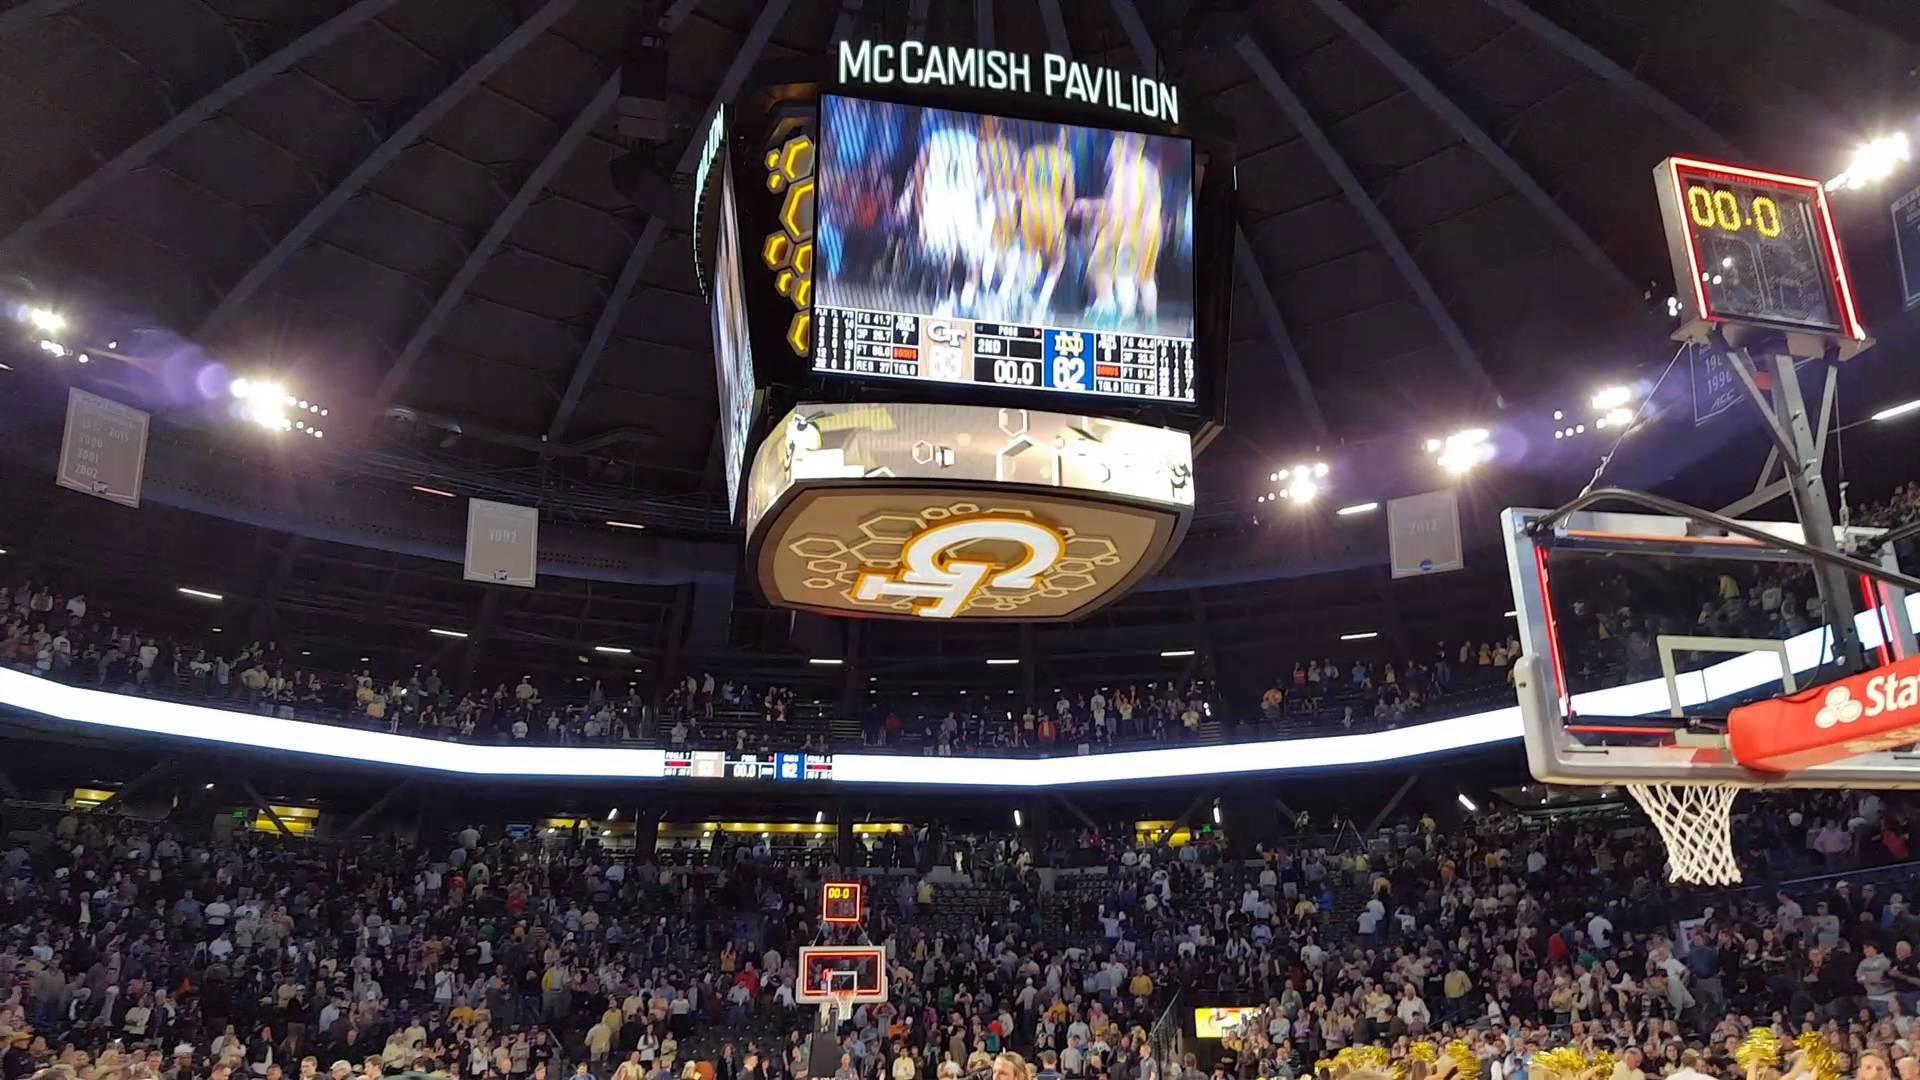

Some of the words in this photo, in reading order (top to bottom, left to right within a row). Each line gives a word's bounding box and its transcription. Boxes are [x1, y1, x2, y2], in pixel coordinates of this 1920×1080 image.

[1043, 52, 1179, 124] PAVILION
[1688, 186, 1781, 238] 00.0
[873, 314, 891, 326] 41.7
[901, 331, 909, 344] 7
[927, 320, 967, 347] GT
[857, 344, 868, 355] FT
[977, 338, 1001, 354] 2ND
[880, 362, 890, 373] 37
[993, 359, 1035, 385] 00.0
[1864, 672, 1920, 717] Sta
[828, 887, 850, 899] 00.0
